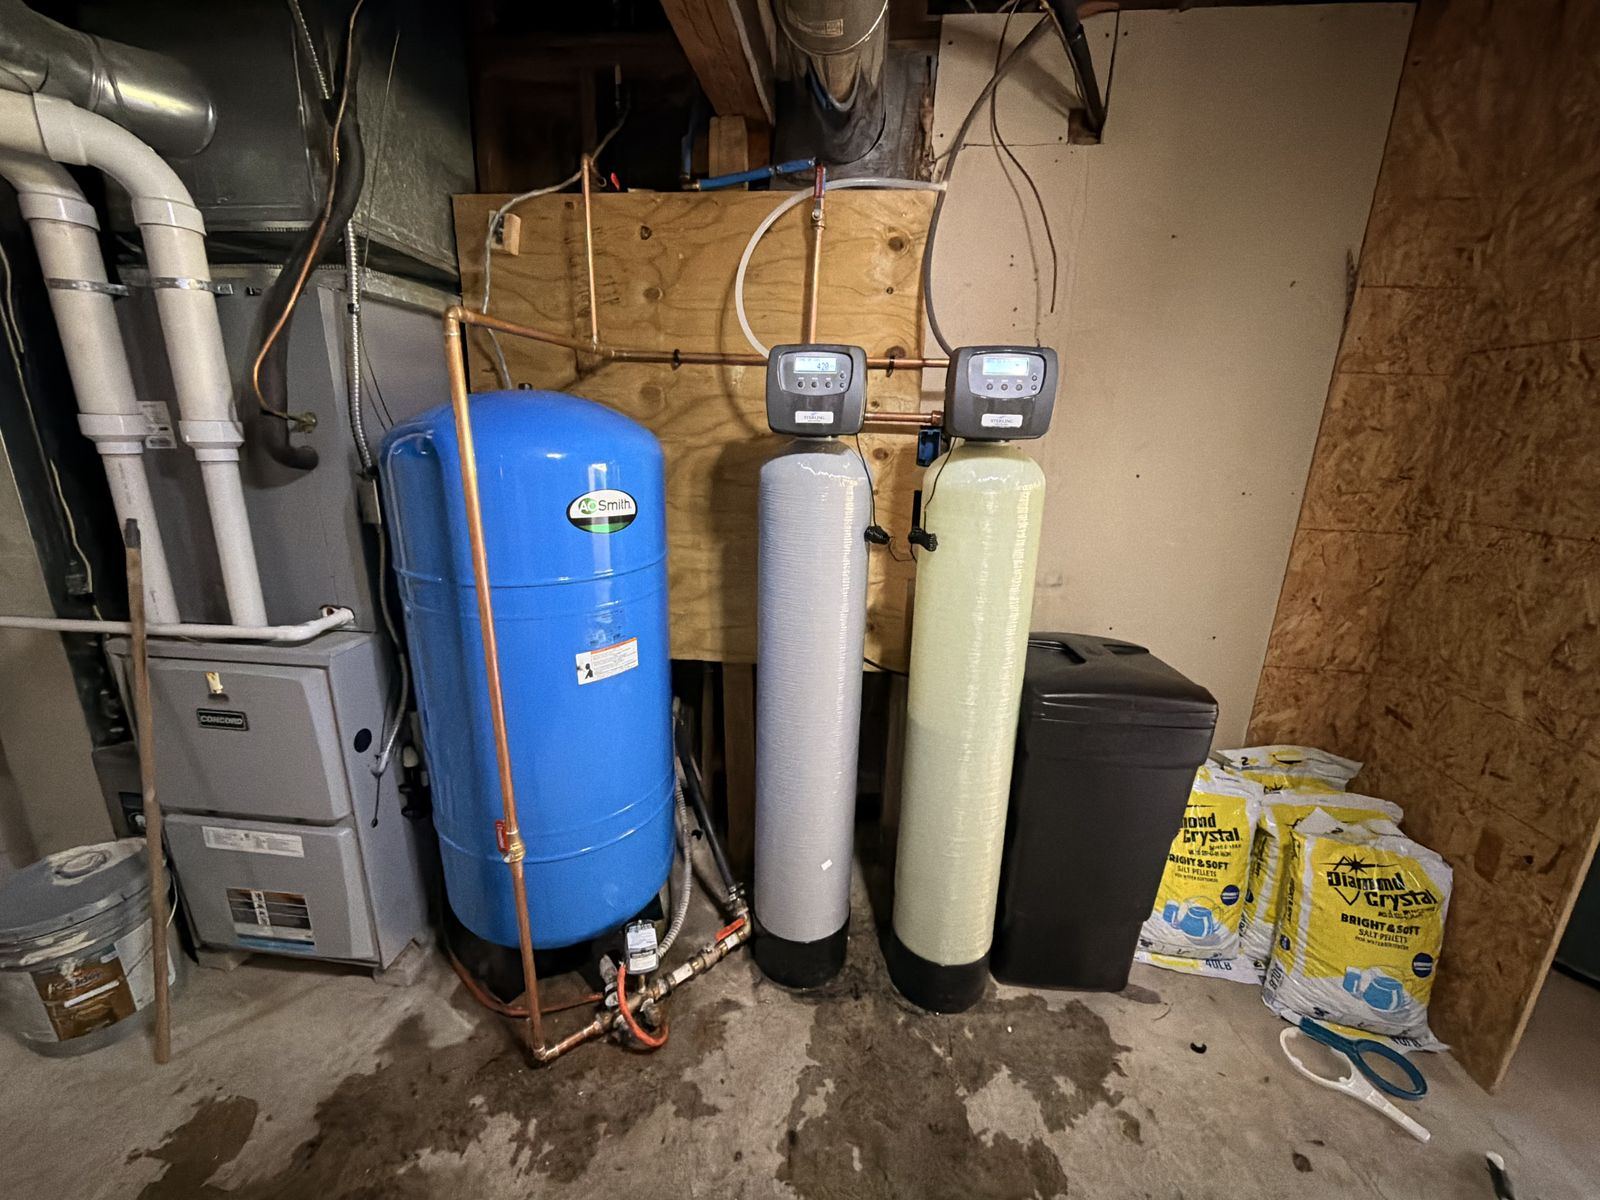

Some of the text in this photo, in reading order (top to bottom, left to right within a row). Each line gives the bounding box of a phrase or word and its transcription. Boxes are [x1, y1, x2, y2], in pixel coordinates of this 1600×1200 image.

[598, 499, 631, 511] Smith
[200, 715, 243, 725] CONCORD
[1183, 827, 1240, 846] Crystal
[1197, 859, 1205, 868] &
[1206, 860, 1228, 869] SOFT
[1364, 889, 1437, 911] Crystal
[1341, 912, 1386, 932] BRIGHT
[1387, 924, 1396, 933] &
[1397, 924, 1421, 936] SOFT
[1359, 928, 1408, 944] SALT PELLETS
